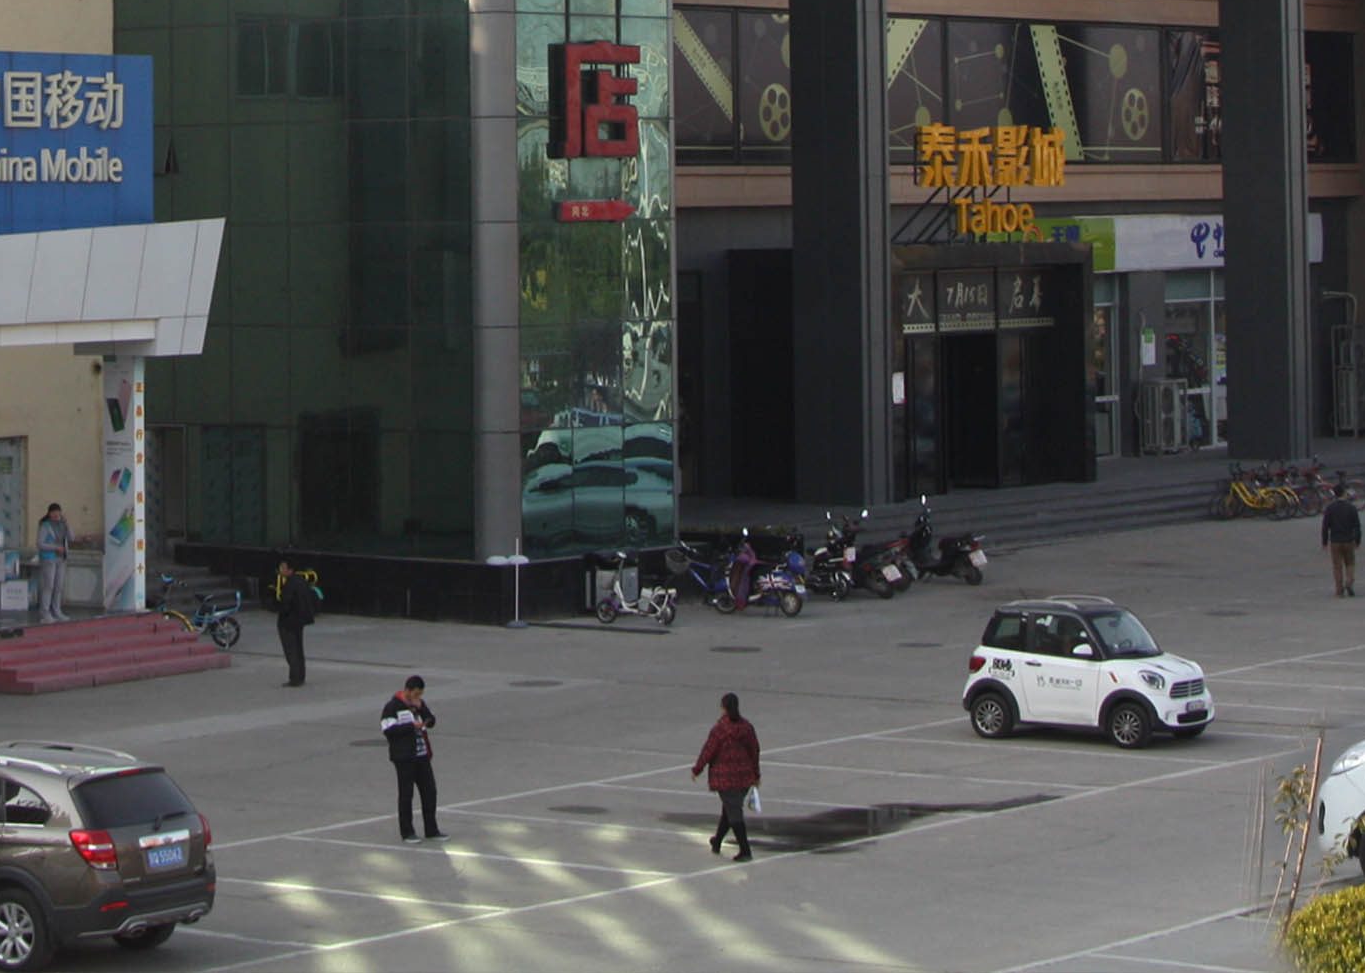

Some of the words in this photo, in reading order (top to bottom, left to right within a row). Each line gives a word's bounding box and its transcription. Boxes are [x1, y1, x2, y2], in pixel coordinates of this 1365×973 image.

[40, 146, 123, 182] Mobile
[916, 123, 1066, 187] 泰禾影城
[951, 198, 1035, 234] Tahoe
